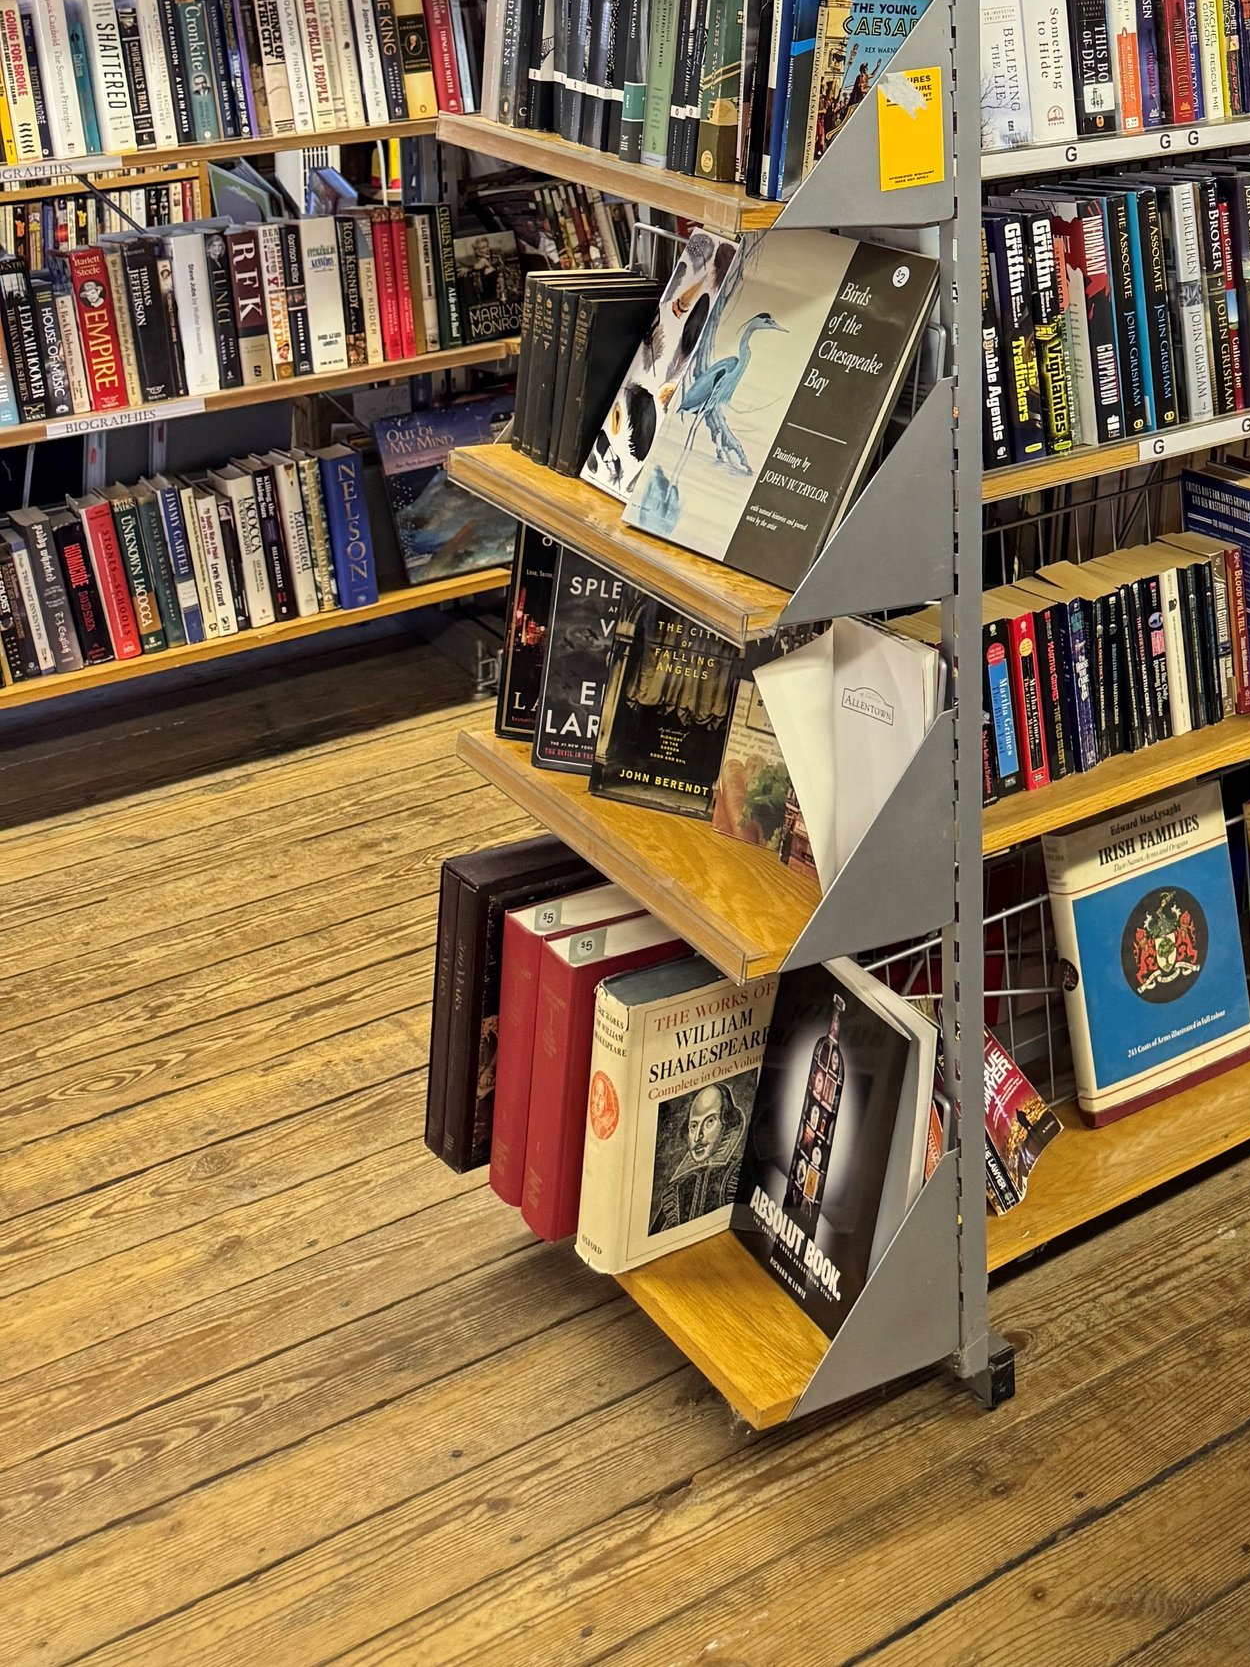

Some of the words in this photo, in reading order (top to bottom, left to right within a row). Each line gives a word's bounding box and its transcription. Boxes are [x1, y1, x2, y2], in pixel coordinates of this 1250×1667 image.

[852, 2, 874, 15] THE
[878, 4, 917, 16] YOUNG
[185, 6, 205, 73] Cronkite
[1037, 21, 1045, 35] to
[1039, 39, 1049, 80] Hide
[1050, 7, 1064, 90] Something
[96, 23, 127, 109] SHATTERED
[1065, 146, 1077, 162] G
[1188, 131, 1199, 145] G
[0, 163, 72, 180] GRAPHIES
[232, 241, 262, 322] RFK
[896, 269, 906, 284] $2
[839, 283, 872, 307] Birds
[828, 313, 841, 331] of
[842, 316, 861, 335] the
[84, 311, 119, 392] EMPIRE
[818, 340, 883, 375] Chesapeake
[803, 368, 829, 398] Bay
[65, 410, 156, 434] BIOGRAPHIES
[772, 446, 801, 468] Paintings
[802, 458, 811, 472] by
[760, 469, 787, 491] JOHN
[786, 476, 799, 494] W.
[796, 480, 829, 503] TAYLOR
[338, 463, 368, 581] NELSON
[746, 515, 756, 524] notes
[756, 518, 764, 527] by
[769, 522, 777, 532] artist
[750, 504, 759, 514] with
[759, 506, 773, 518] natural
[772, 511, 788, 523] histories
[787, 517, 795, 526] and
[793, 519, 807, 531] journal
[294, 511, 311, 571] Educated
[658, 621, 684, 635] THE
[690, 627, 721, 641] CITY
[682, 640, 692, 648] OF
[654, 648, 715, 668] FALLING
[656, 661, 709, 680] ANGELS
[844, 697, 893, 722] ALLENTOWN
[619, 768, 650, 785] JOHN
[654, 776, 709, 797] BERENDT
[1110, 819, 1137, 837] Edward
[1137, 803, 1182, 828] MacLysaght
[1099, 839, 1136, 868] IRISH
[1138, 814, 1200, 856] FAMILIES
[543, 910, 555, 924] $5
[580, 939, 593, 952] $5
[654, 1009, 691, 1034] THE
[693, 991, 749, 1024] WORKS
[752, 980, 776, 1005] OF
[674, 1007, 754, 1051] WILLIAM
[1128, 1045, 1137, 1058] 243
[1137, 1039, 1152, 1055] Coats
[1152, 1038, 1158, 1049] of
[1157, 1034, 1171, 1046] Arms
[1170, 1021, 1197, 1043] illustrated
[1195, 1023, 1201, 1032] in
[1201, 1017, 1211, 1030] full
[1209, 1009, 1226, 1025] colour
[648, 1030, 771, 1084] SHAKESPEARE
[648, 1075, 700, 1101] Complete
[700, 1069, 712, 1085] in
[712, 1063, 733, 1083] One
[582, 1233, 603, 1257] OXFORD
[750, 1185, 805, 1257] ABSOLUT
[803, 1238, 843, 1301] BOOK.
